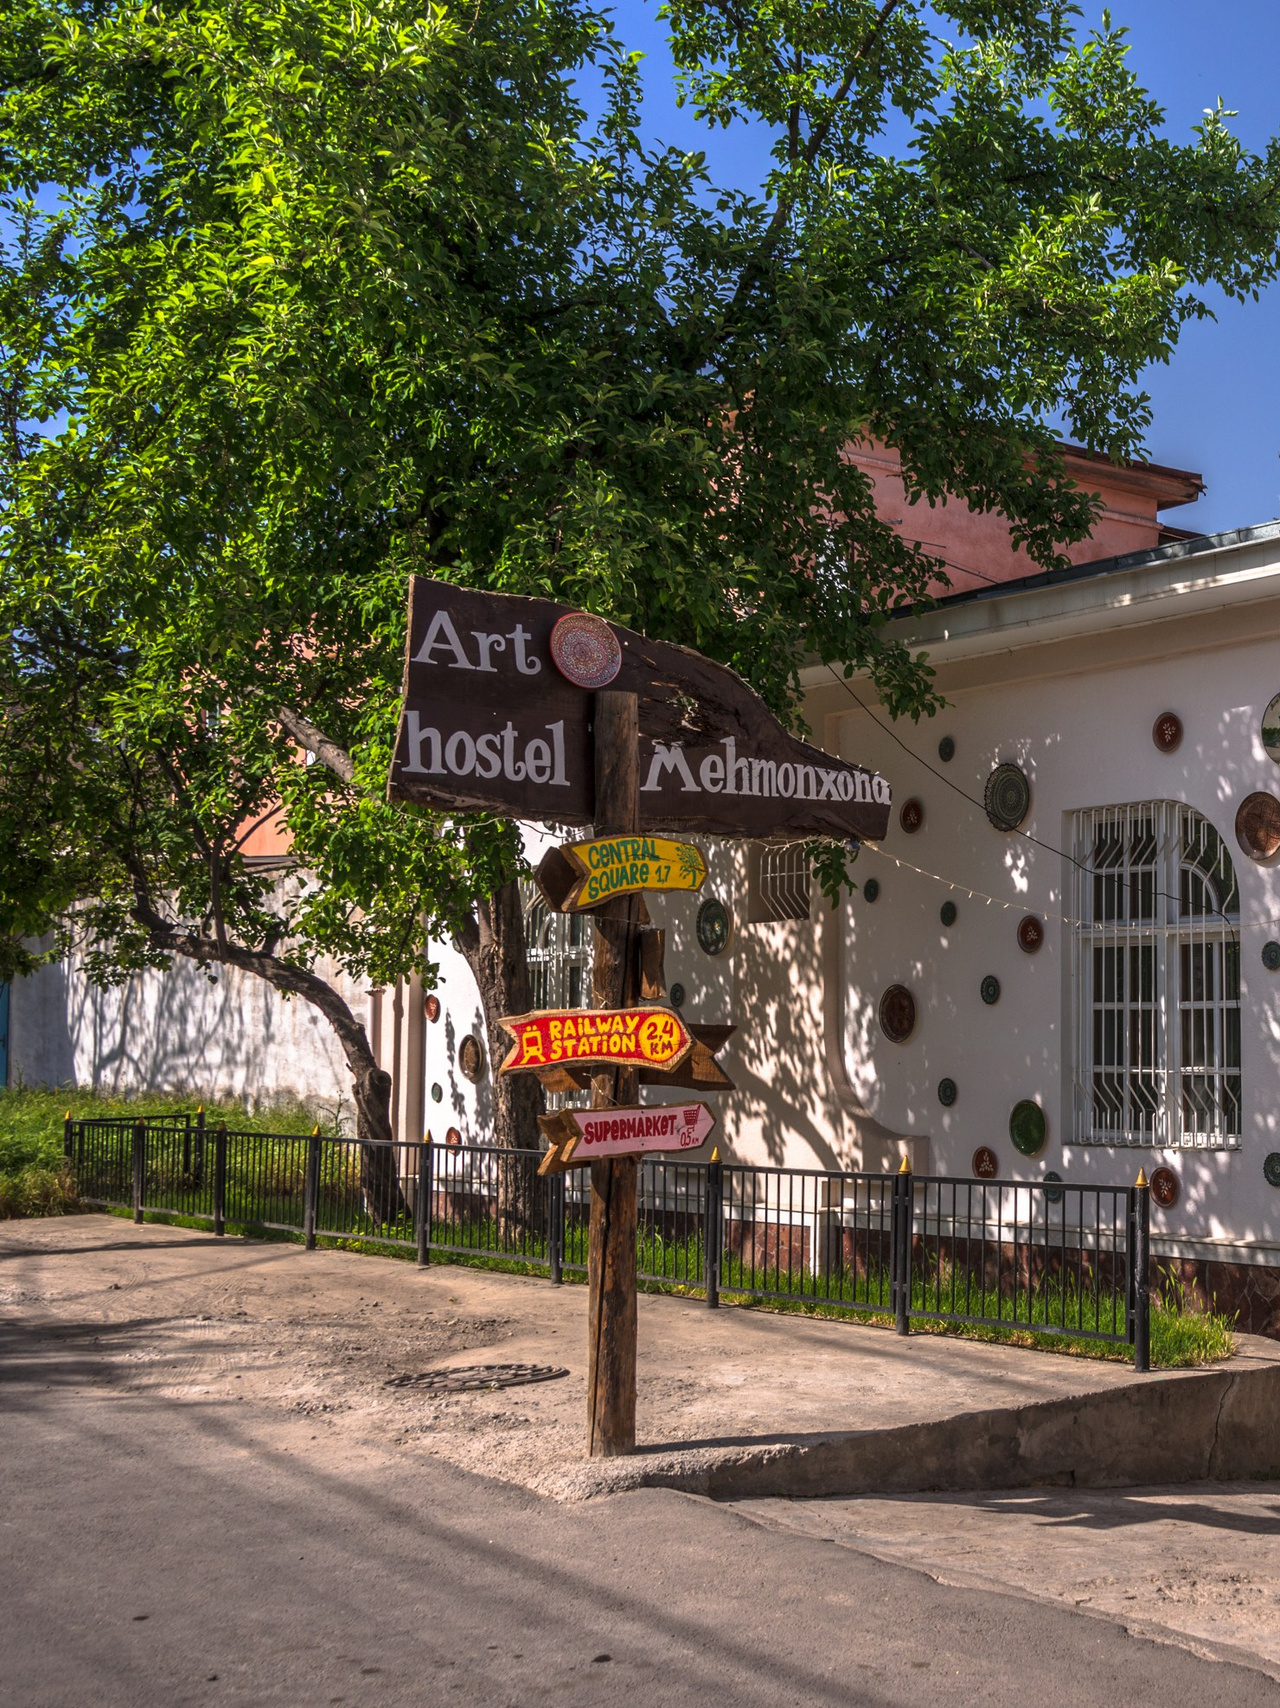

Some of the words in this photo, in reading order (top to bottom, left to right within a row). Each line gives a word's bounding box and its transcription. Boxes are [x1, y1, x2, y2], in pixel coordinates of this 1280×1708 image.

[411, 610, 542, 676] Art
[401, 710, 571, 787] hostel
[640, 735, 893, 805] Mehmonxona
[655, 865, 671, 884] 1,7
[646, 1020, 674, 1042] 2,4
[650, 1040, 673, 1056] KM
